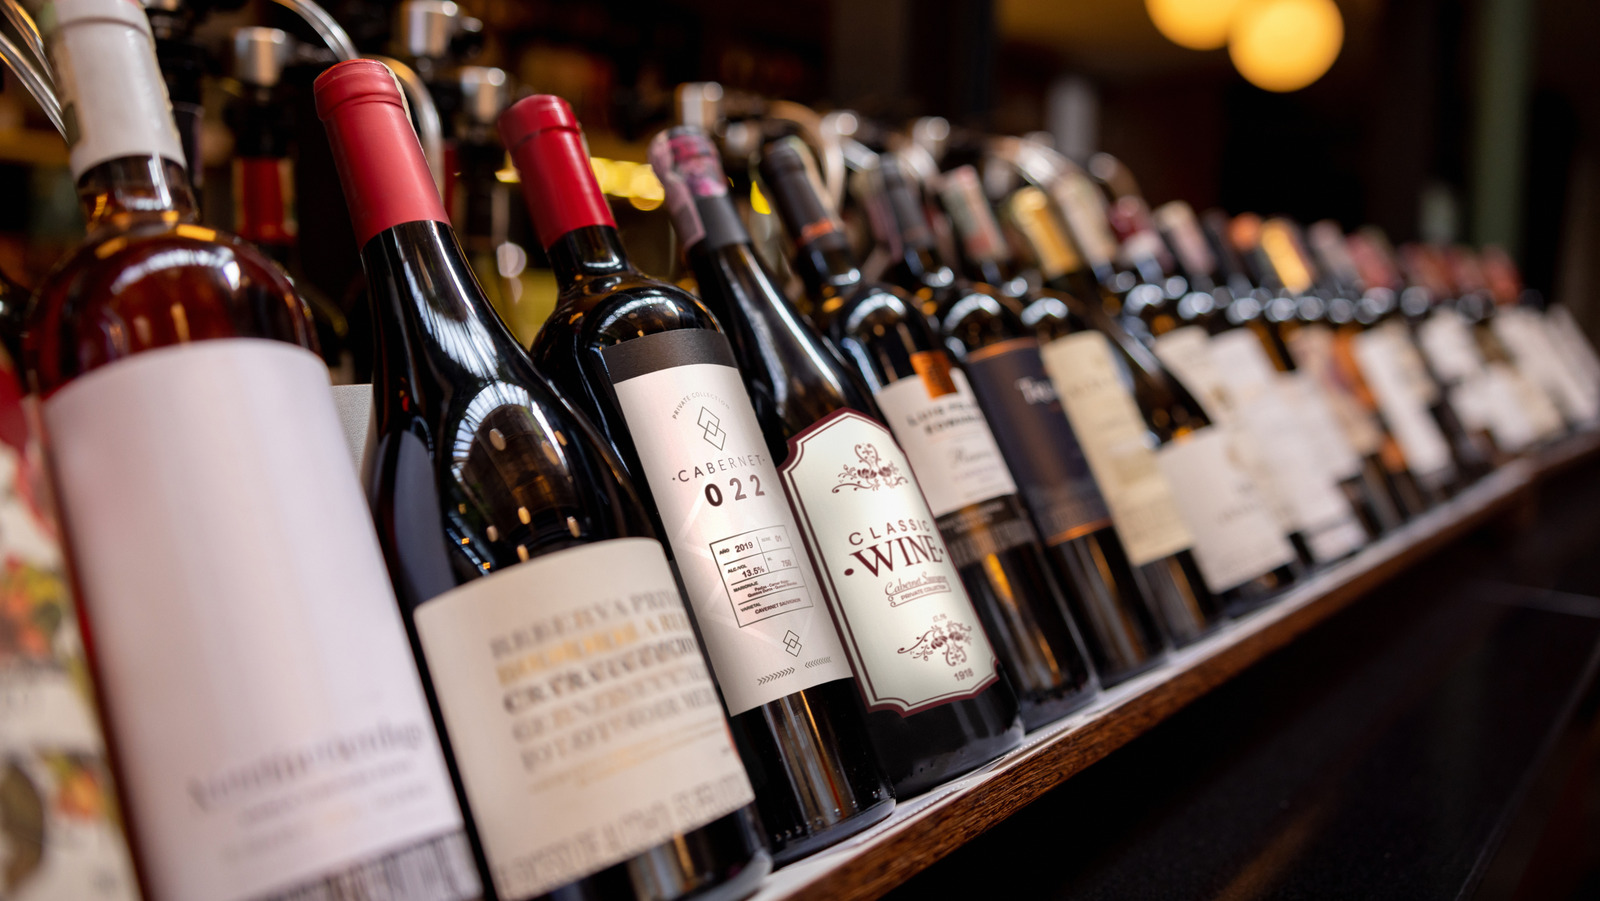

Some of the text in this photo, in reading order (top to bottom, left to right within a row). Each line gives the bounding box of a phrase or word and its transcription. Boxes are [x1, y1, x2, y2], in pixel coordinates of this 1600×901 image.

[672, 391, 731, 420] PRIVATE COLLECTION
[678, 454, 762, 482] CABERNET
[704, 474, 766, 507] 022
[848, 518, 930, 546] CLASSIC
[734, 541, 754, 553] 2019
[848, 534, 943, 578] WINE
[741, 566, 765, 578] 13.5%
[900, 588, 924, 601] PRIVATE
